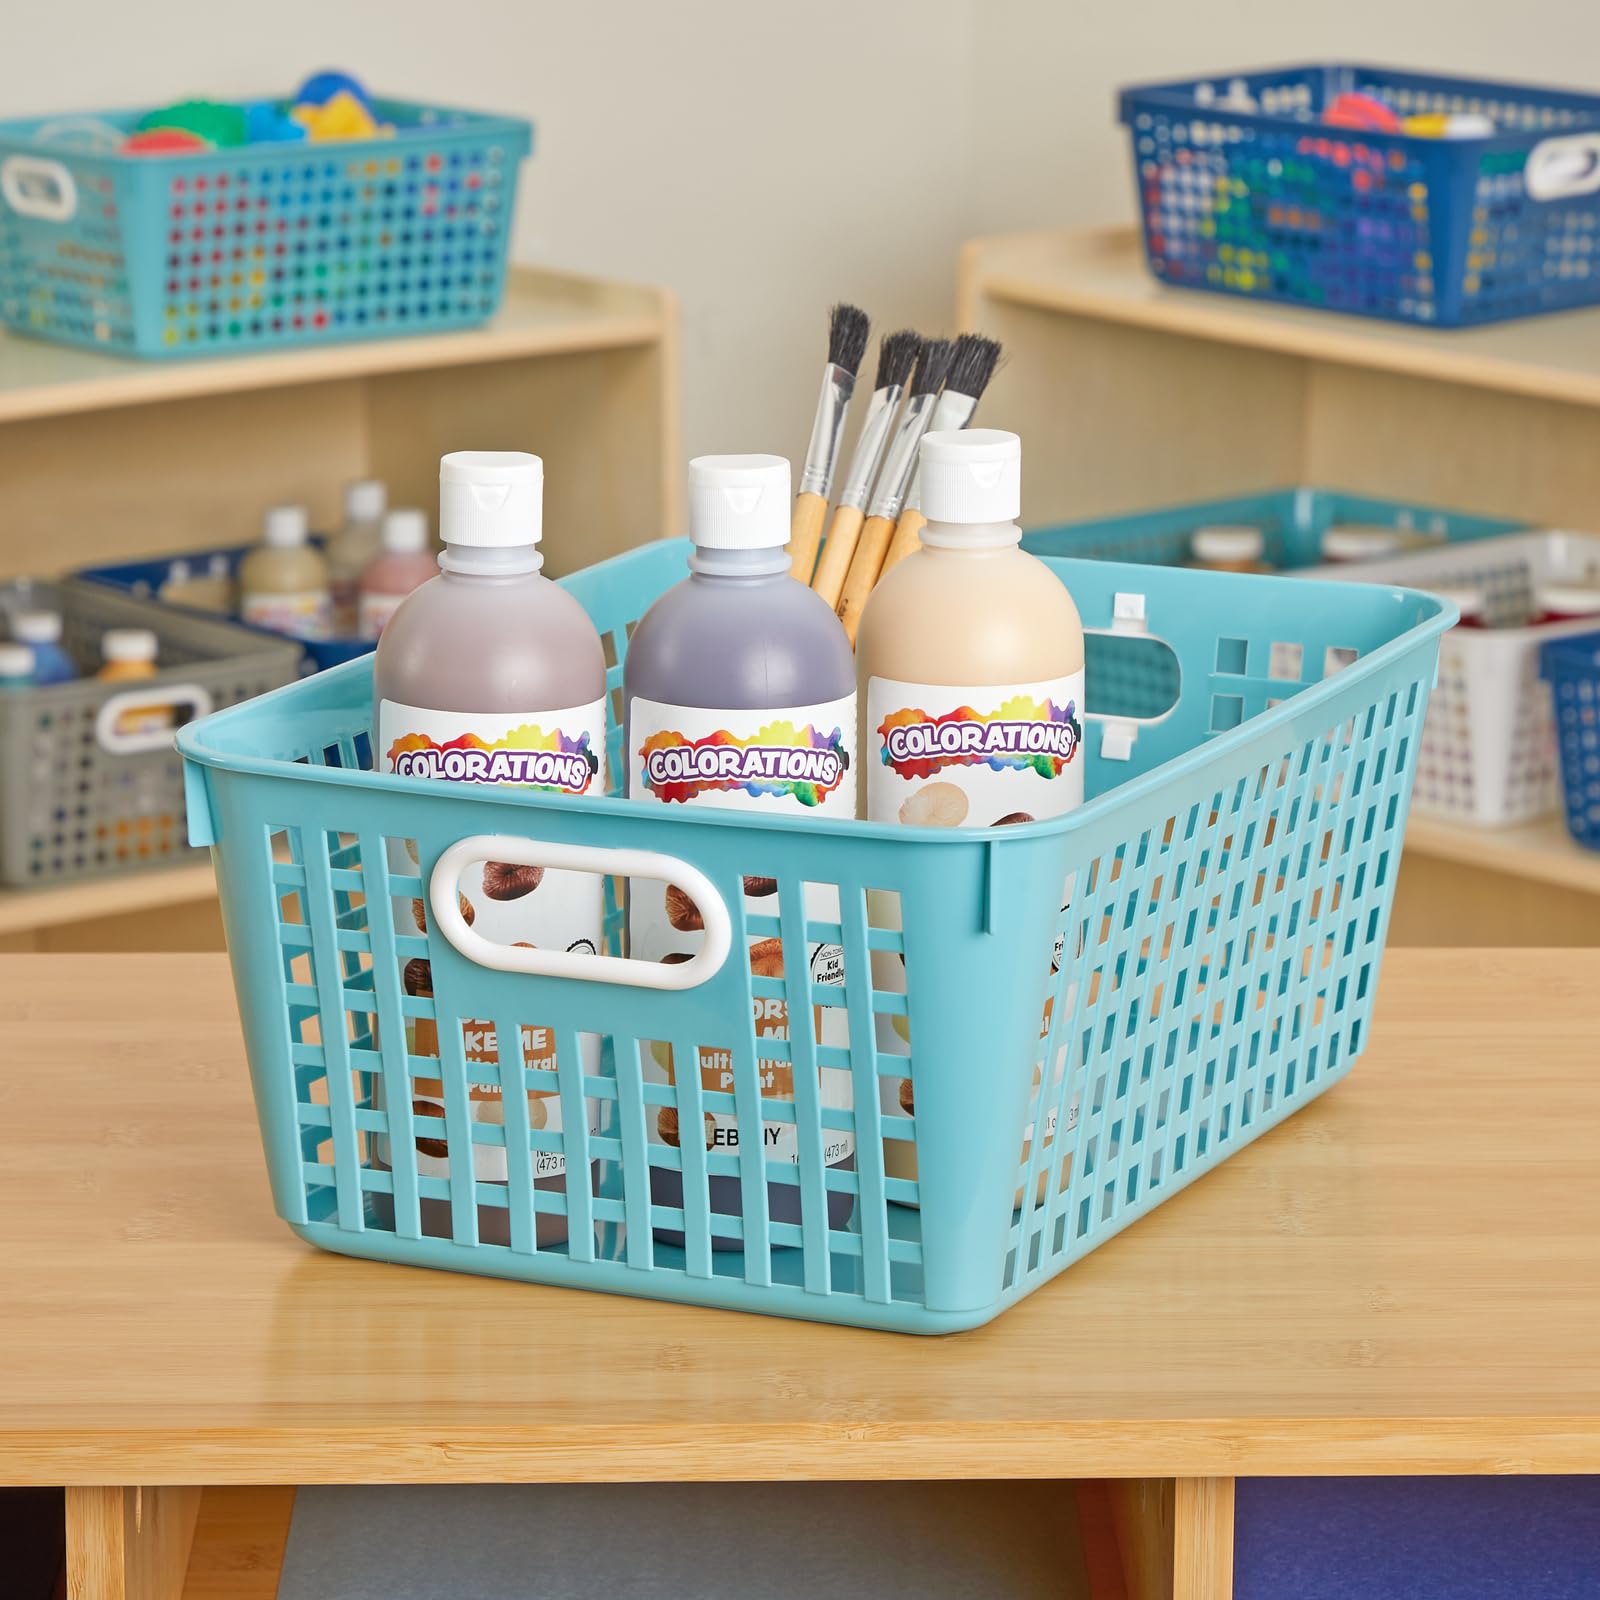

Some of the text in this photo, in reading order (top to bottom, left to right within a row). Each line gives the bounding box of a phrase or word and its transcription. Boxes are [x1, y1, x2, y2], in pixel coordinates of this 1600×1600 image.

[889, 724, 1073, 758] COLORATIONS
[397, 748, 589, 790] COLORATIONS
[650, 748, 838, 785] COLORATIONS
[827, 958, 839, 970] Kid
[713, 1127, 781, 1146] EBY
[536, 1156, 558, 1174] (473
